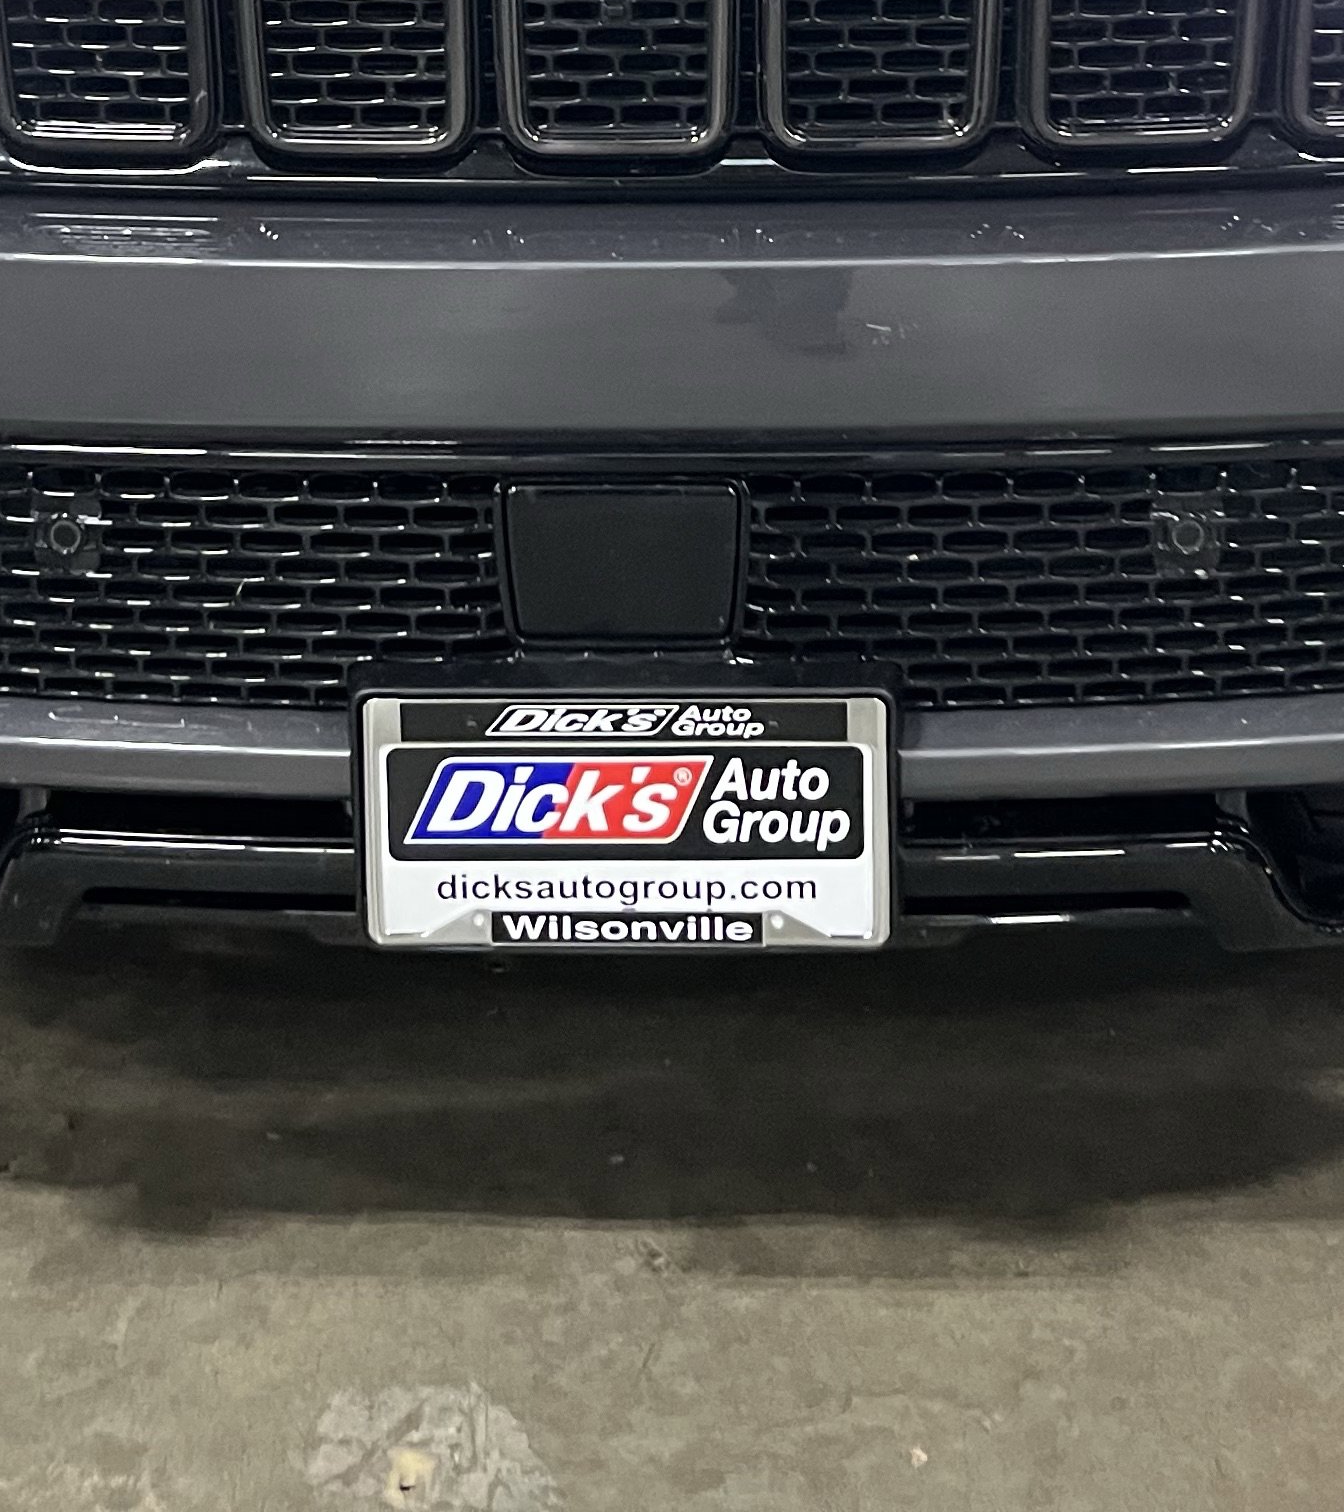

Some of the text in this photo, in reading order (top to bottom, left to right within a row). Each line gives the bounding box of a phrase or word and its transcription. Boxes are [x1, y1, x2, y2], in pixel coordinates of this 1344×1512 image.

[498, 707, 668, 734] Dick's
[681, 703, 752, 722] Auto
[671, 719, 765, 739] Group
[711, 757, 830, 801] Auto
[426, 765, 674, 834] Dick's
[702, 802, 851, 851] Group
[436, 873, 818, 906] dicksautogroup.com
[502, 913, 754, 942] Wilsonville
